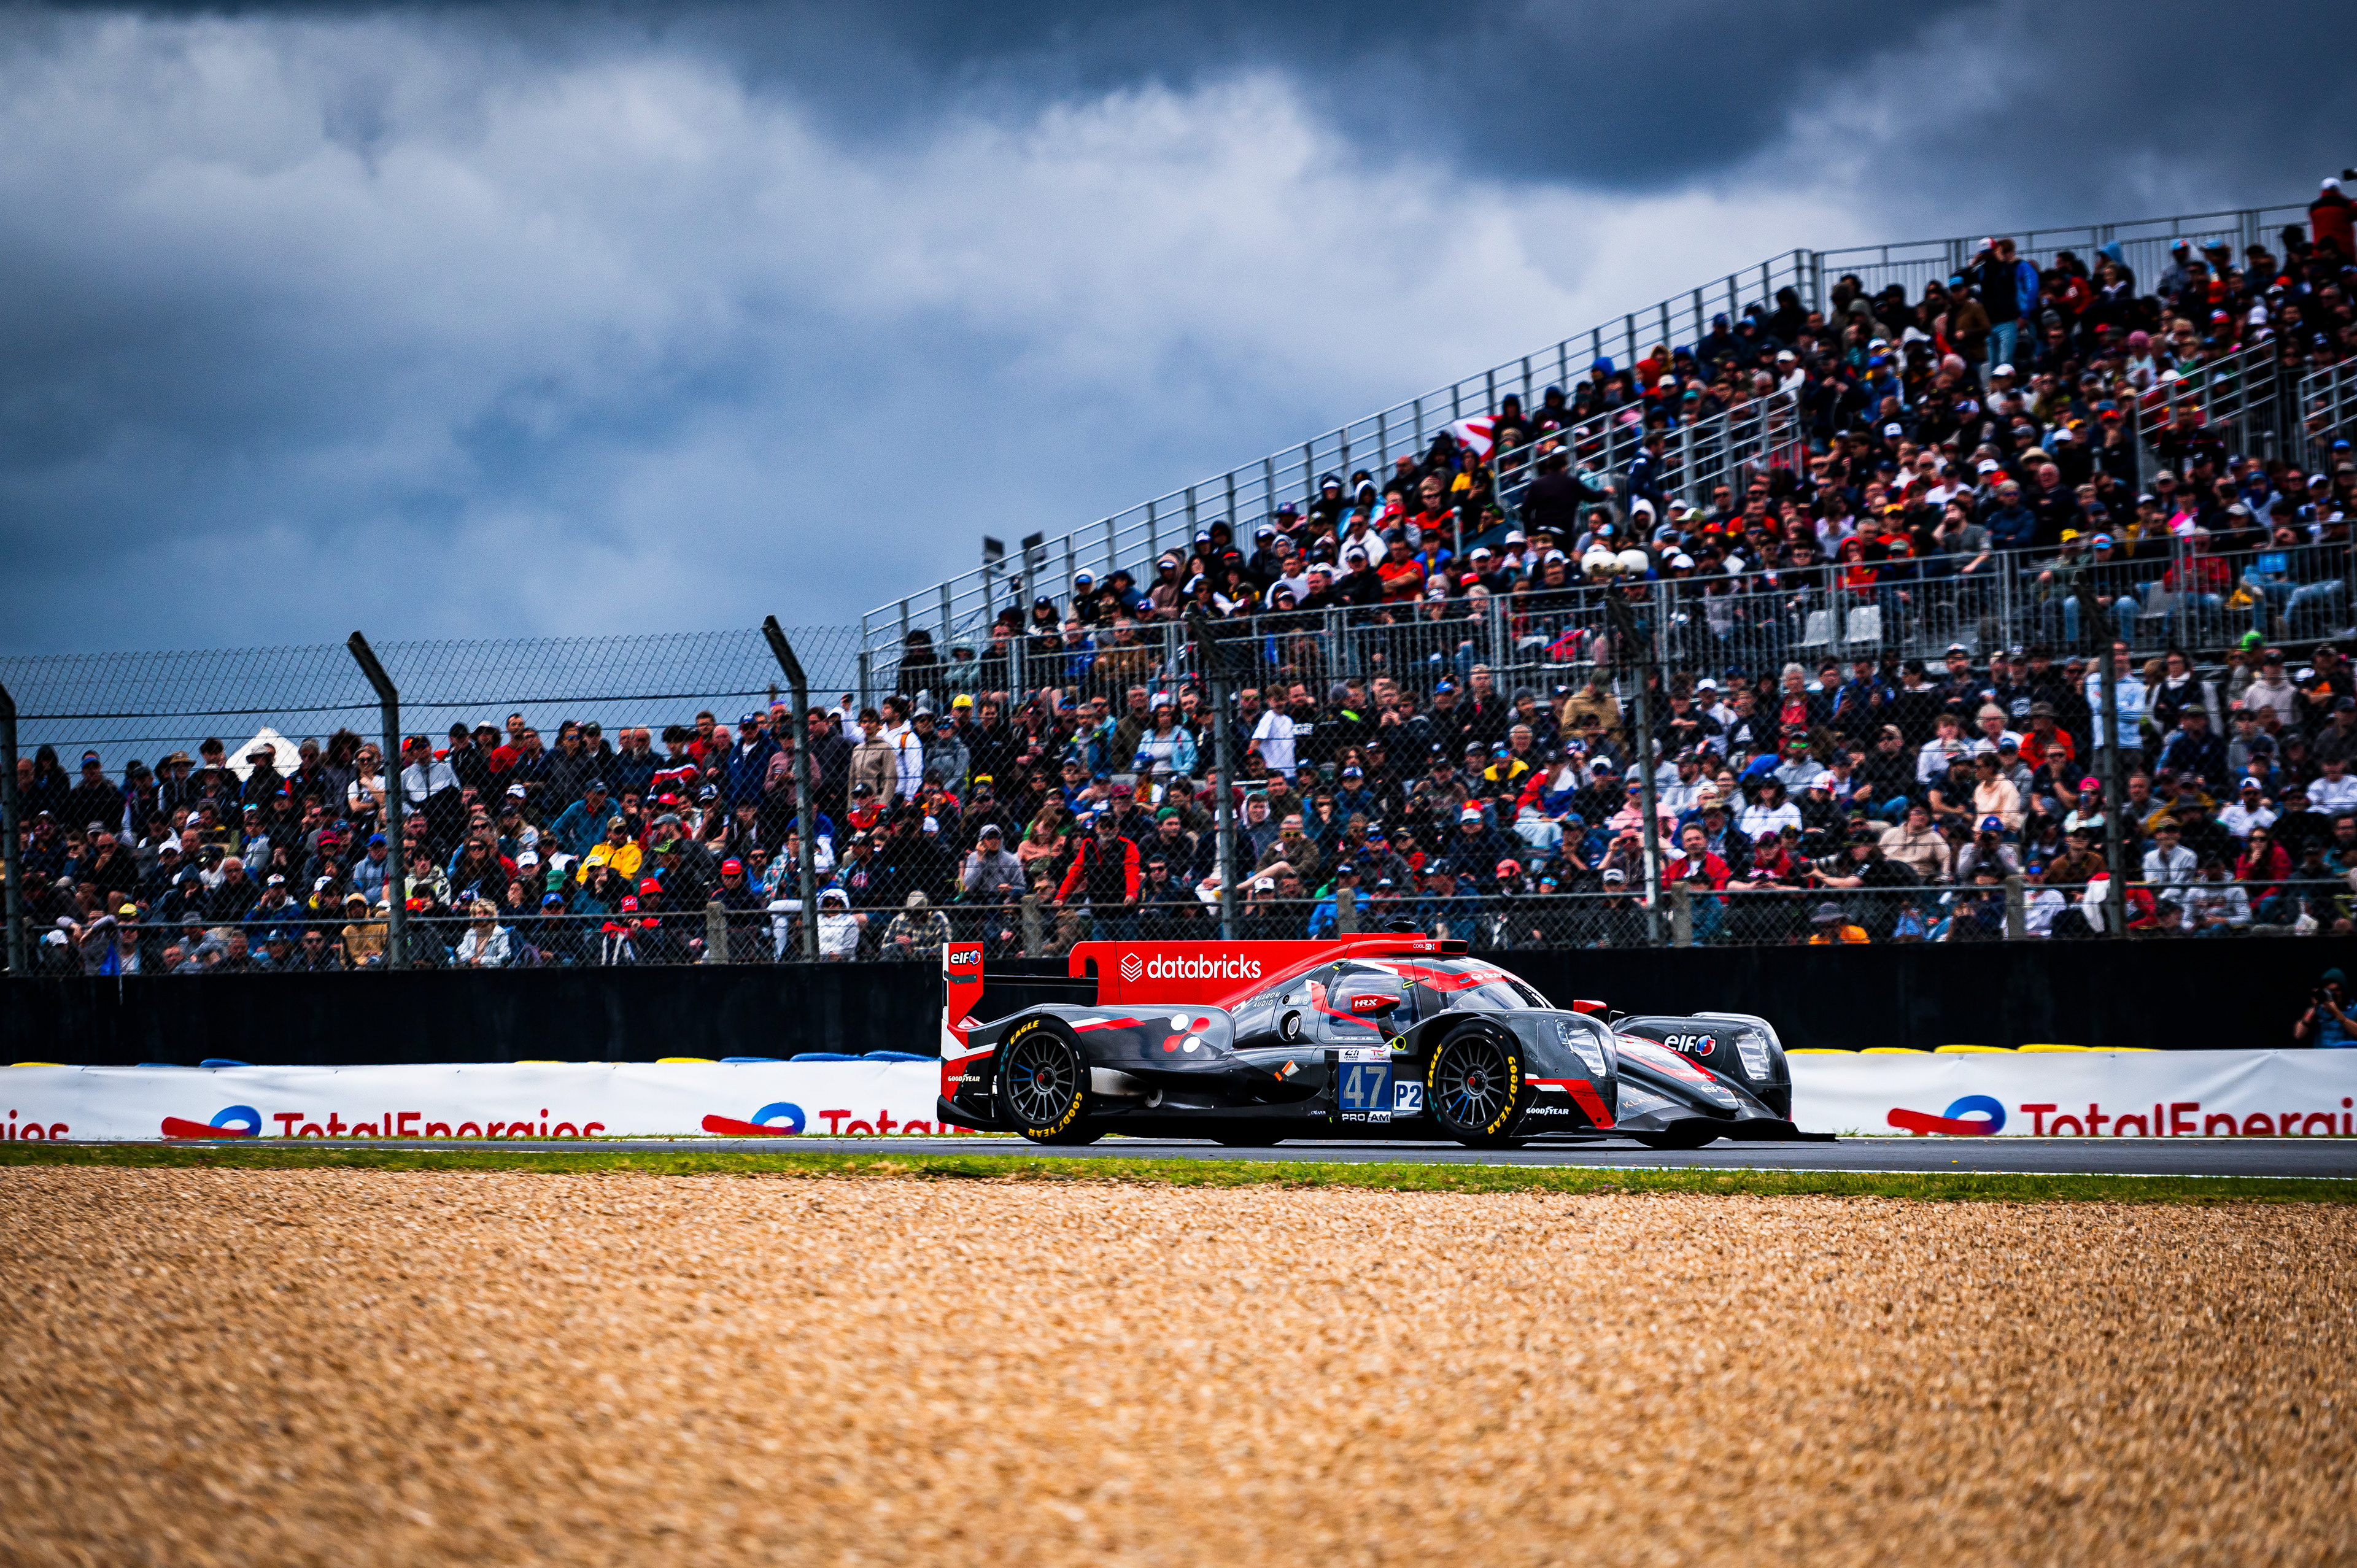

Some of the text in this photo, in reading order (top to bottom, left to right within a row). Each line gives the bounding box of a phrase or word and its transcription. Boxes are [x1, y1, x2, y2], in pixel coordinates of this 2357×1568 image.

[950, 952, 970, 964] elf
[1147, 953, 1261, 979] databricks
[1253, 999, 1274, 1008] AUDIO
[1254, 992, 1280, 1001] WISDOM
[1010, 1019, 1040, 1045] EAGLE
[1664, 1035, 1697, 1052] elf
[1428, 1043, 1443, 1088] EAGLE
[948, 1073, 980, 1083] GOODYEAR
[1343, 1065, 1387, 1108] 47
[1395, 1084, 1422, 1108] P2
[1487, 1056, 1519, 1134] GOODYEAR
[1701, 1084, 1719, 1093] elf
[1028, 1092, 1083, 1137] GOODYEAR
[1526, 1106, 1569, 1116] GOODYEAR
